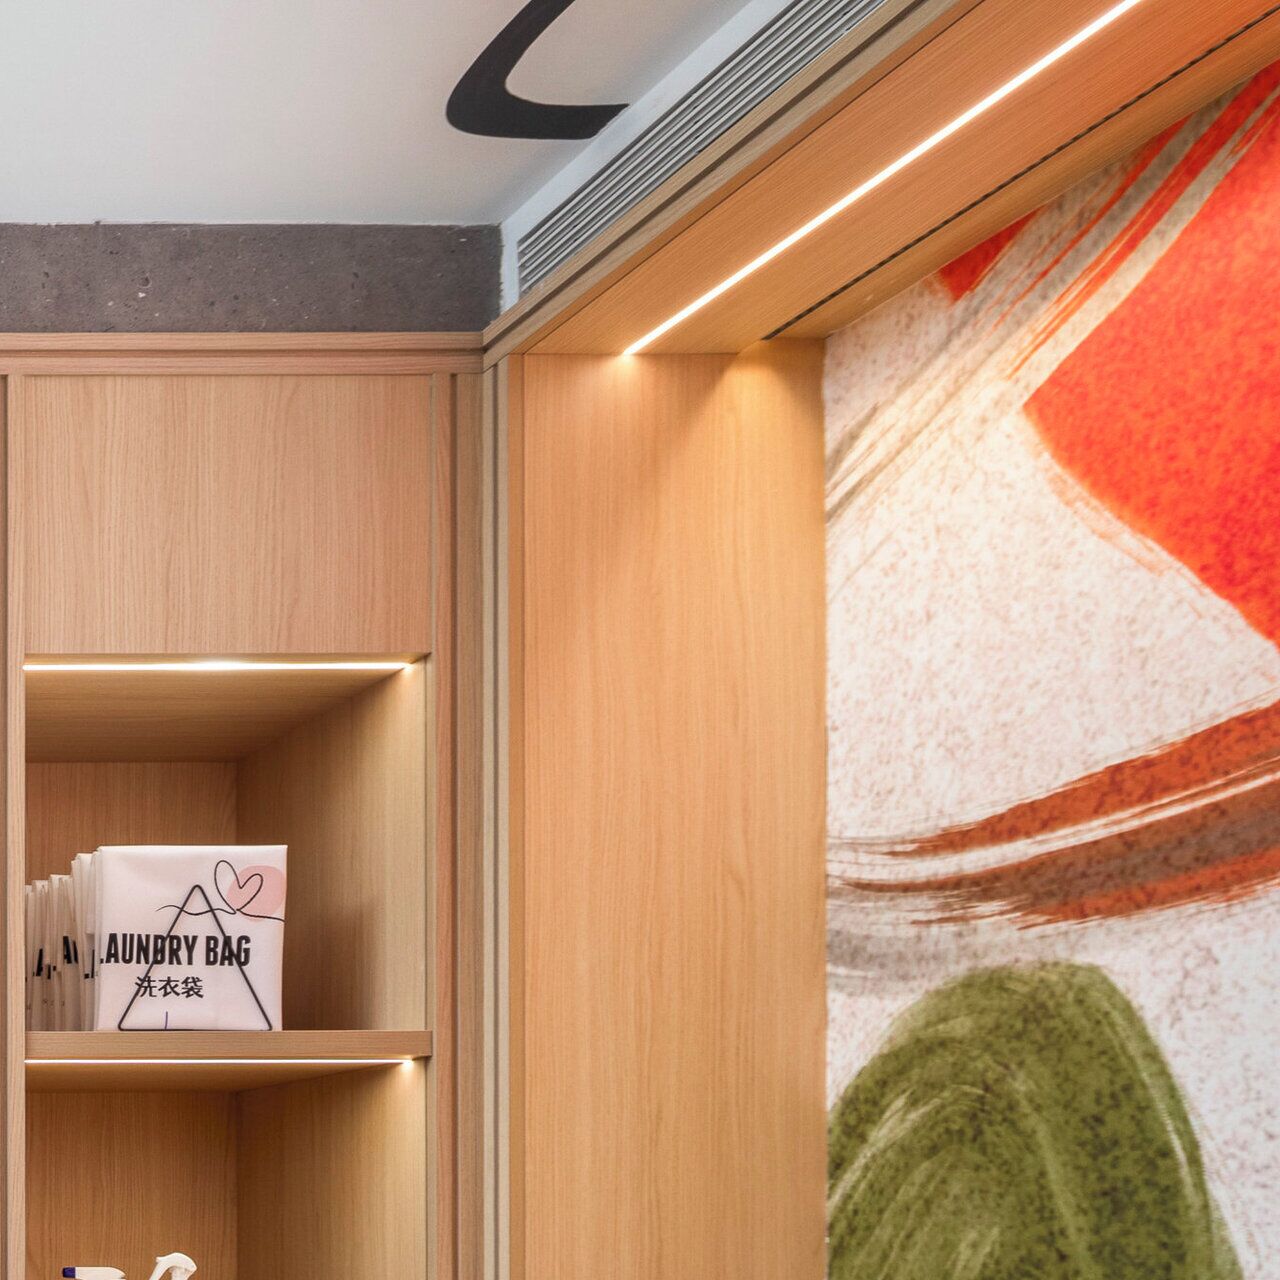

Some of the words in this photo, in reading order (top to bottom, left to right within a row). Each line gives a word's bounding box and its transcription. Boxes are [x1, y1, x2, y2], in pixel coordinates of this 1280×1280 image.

[100, 933, 199, 966] AUNDRY
[205, 935, 251, 967] BAG
[135, 976, 204, 998] 洗衣袋
